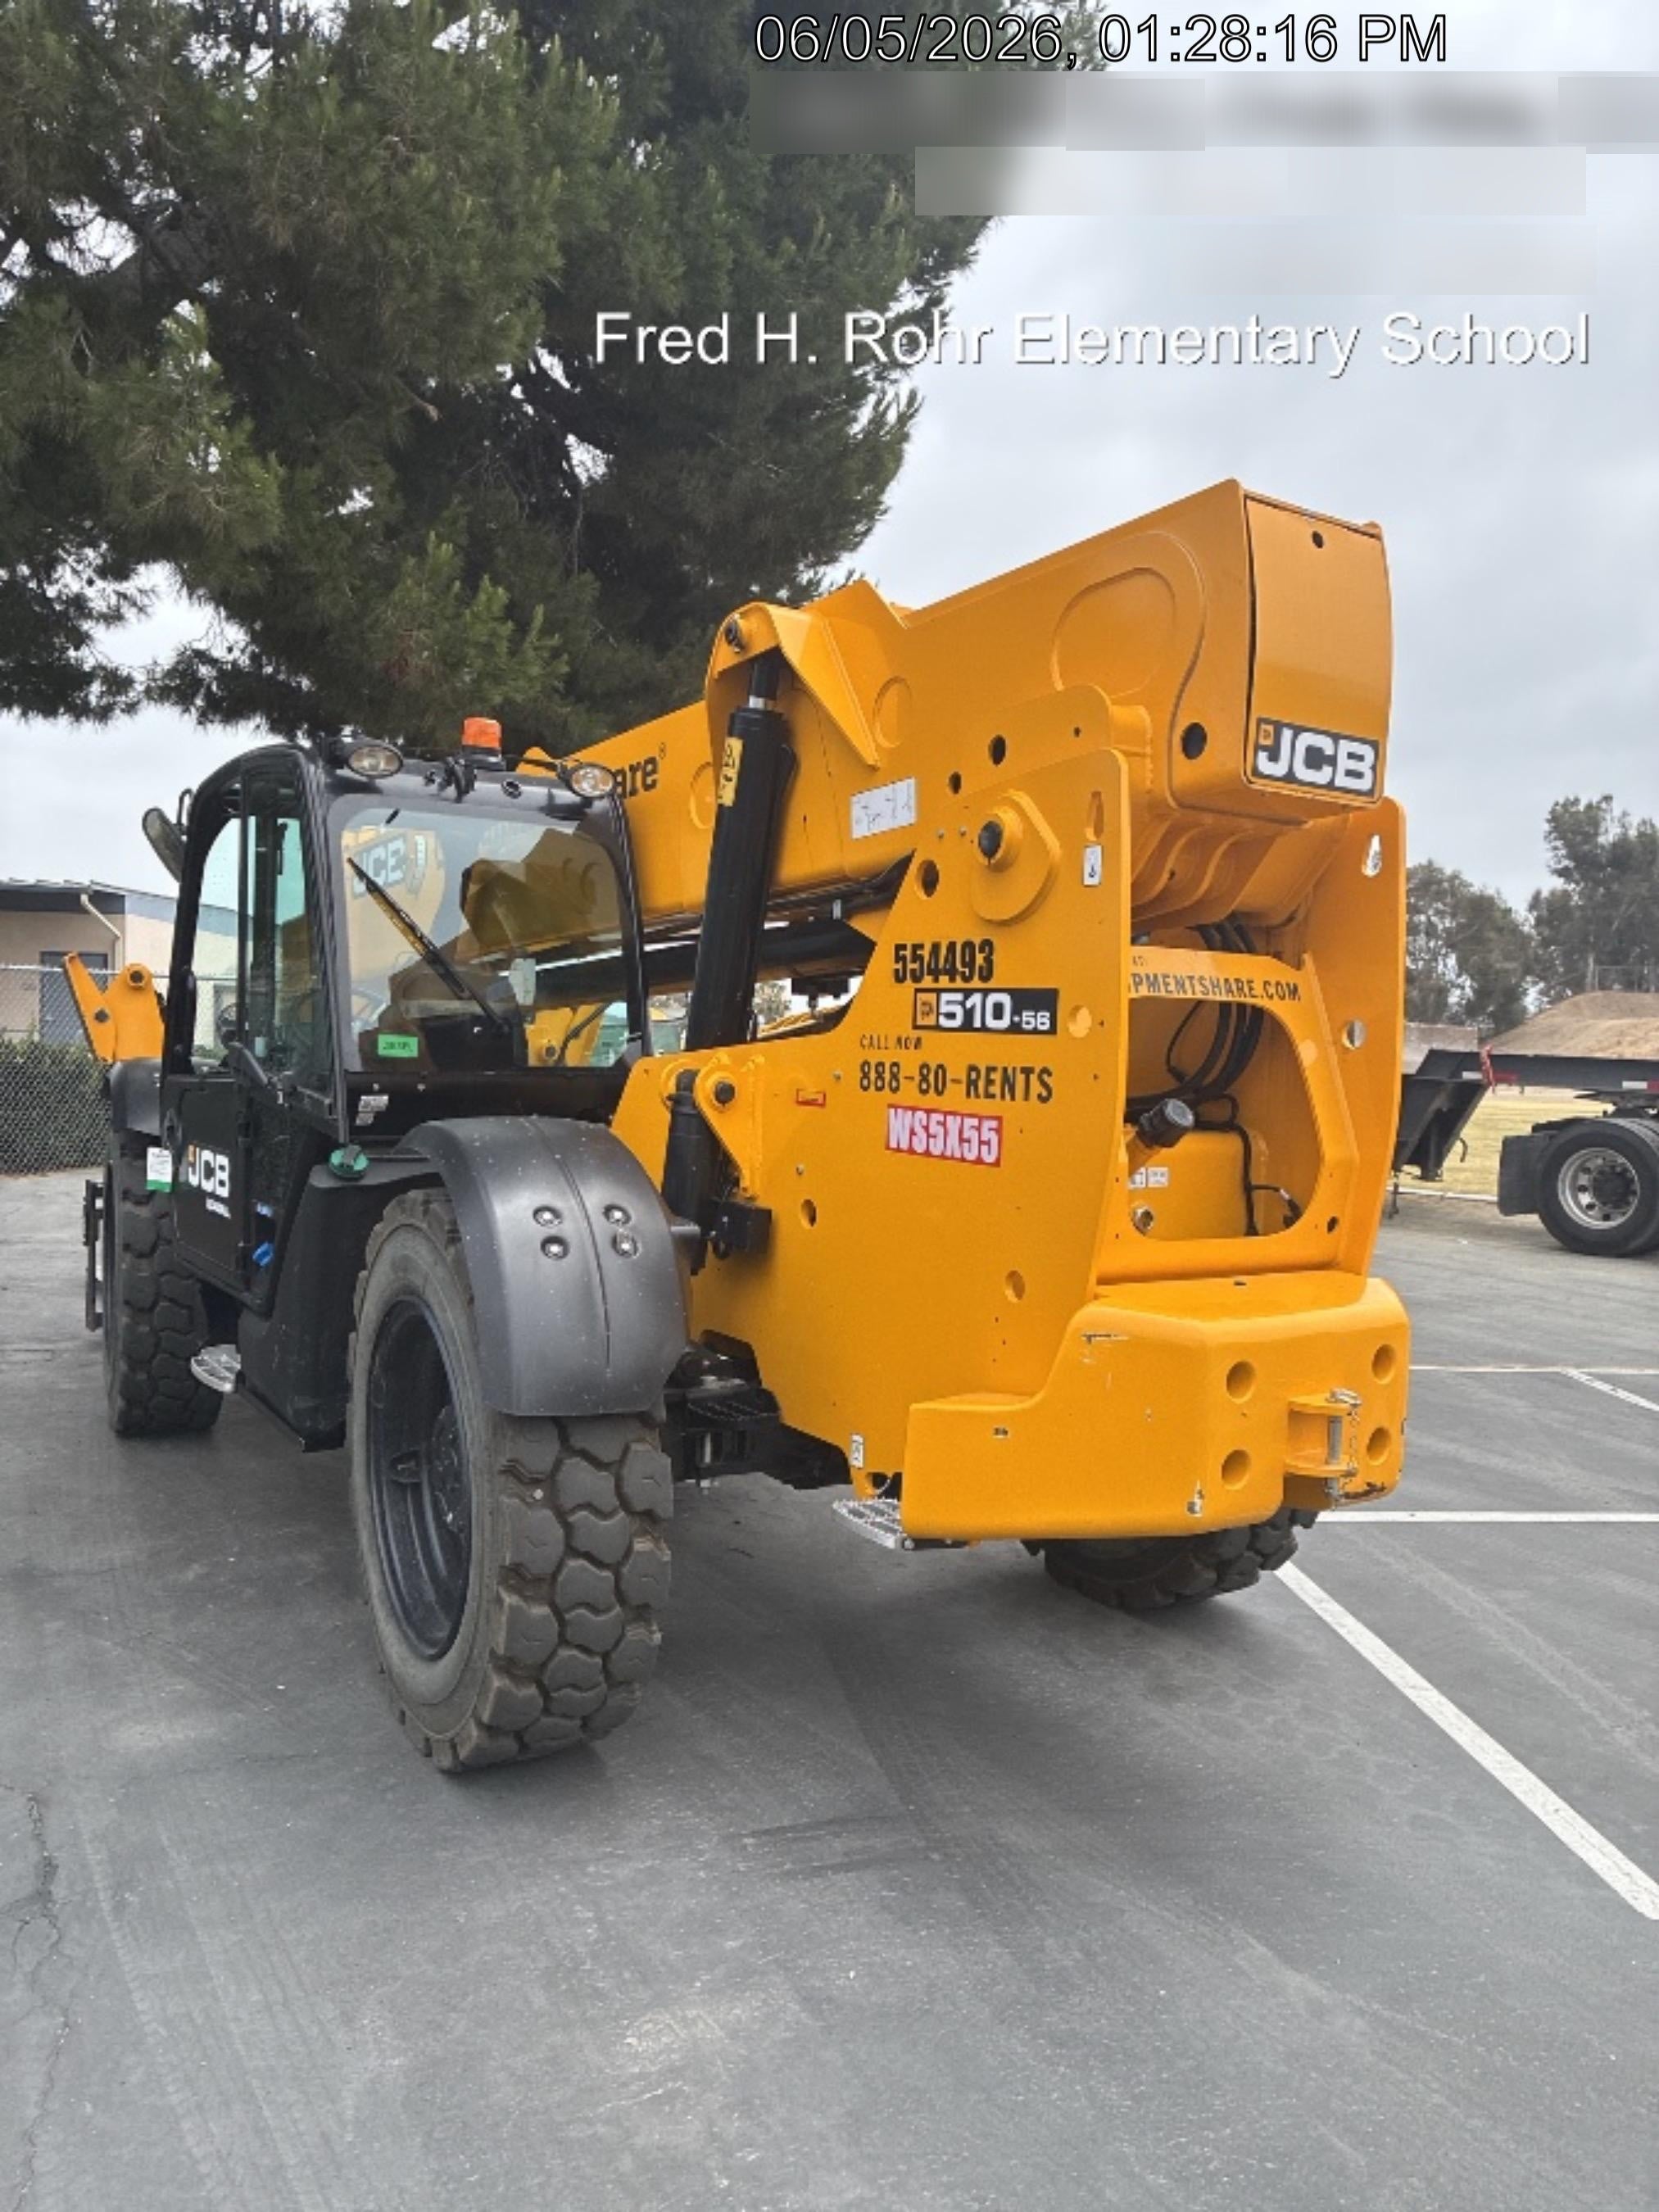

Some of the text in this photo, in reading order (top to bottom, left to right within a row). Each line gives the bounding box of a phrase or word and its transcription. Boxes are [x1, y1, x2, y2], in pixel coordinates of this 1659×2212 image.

[1257, 727, 1375, 791] JCB
[893, 939, 995, 984] 554493
[860, 1034, 922, 1050] CALL NOW
[859, 1059, 1054, 1104] 888-80-RENTS
[188, 1146, 229, 1198] JCB
